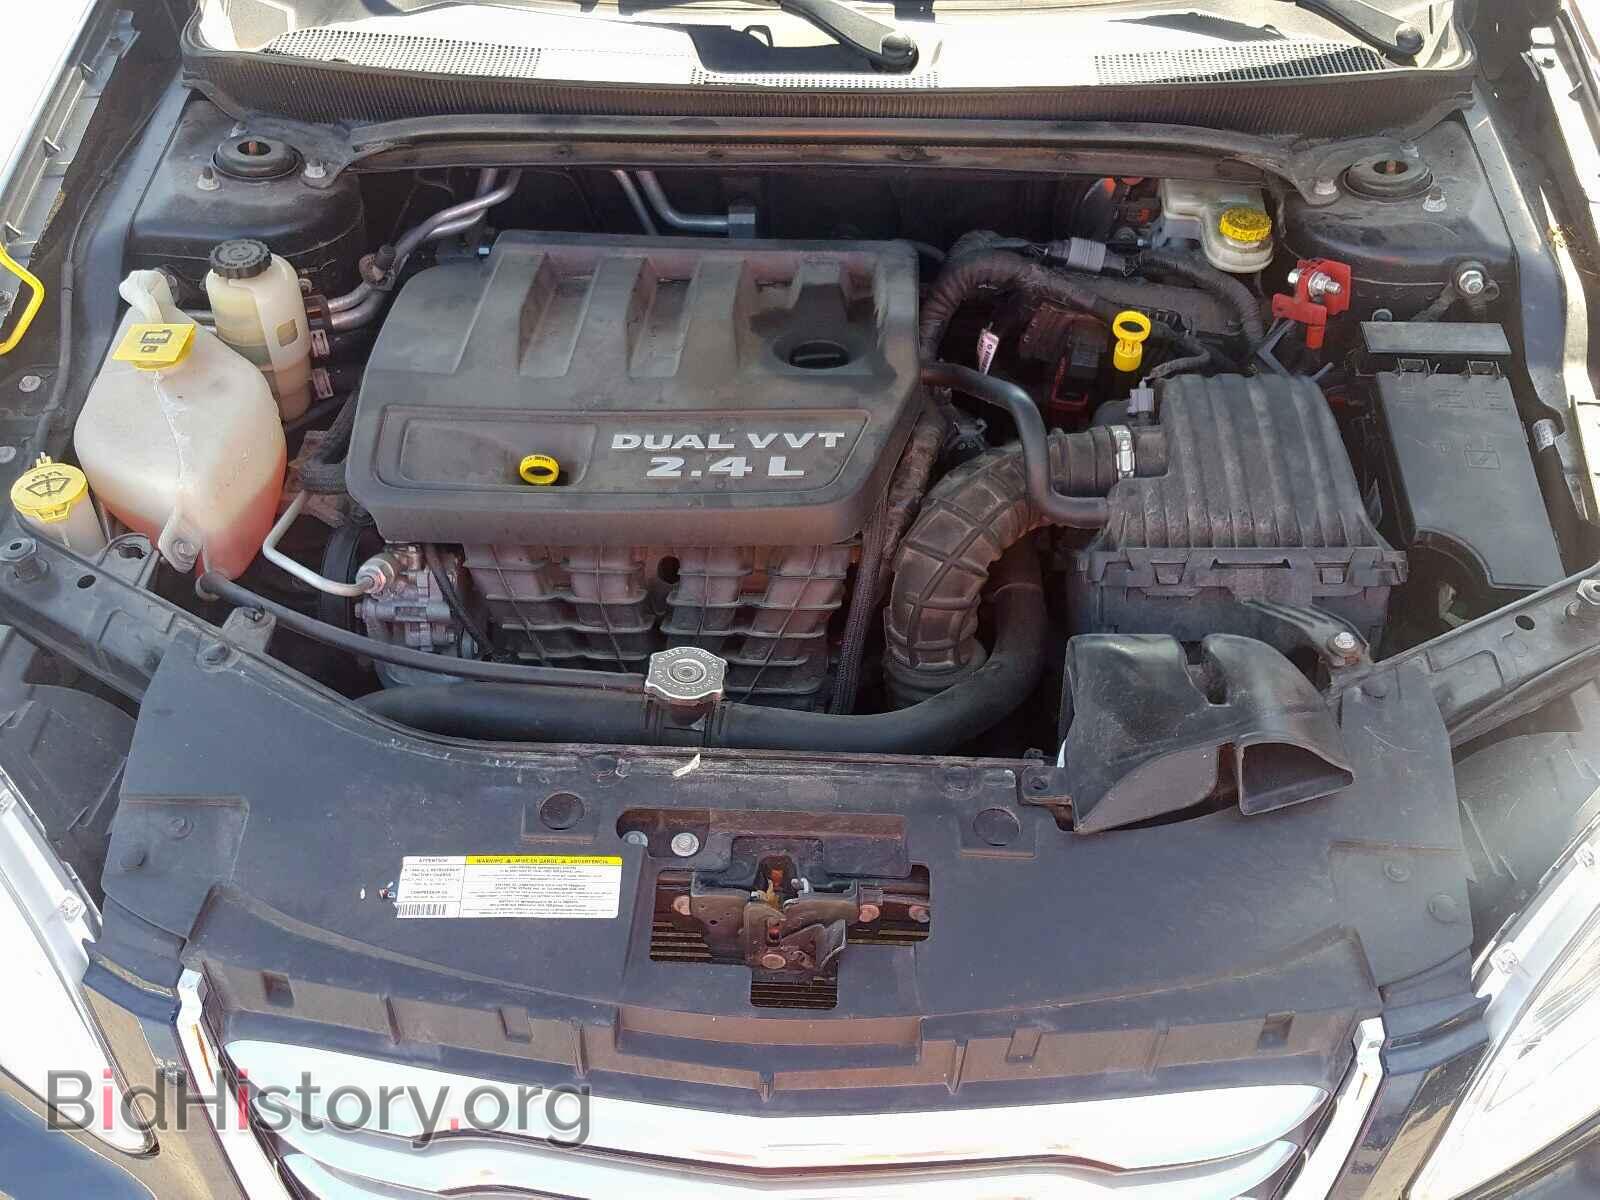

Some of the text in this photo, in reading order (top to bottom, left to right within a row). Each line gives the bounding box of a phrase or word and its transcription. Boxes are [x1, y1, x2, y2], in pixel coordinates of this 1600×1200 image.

[611, 432, 845, 449] DUAL VVT
[646, 456, 804, 477] 2.4 L
